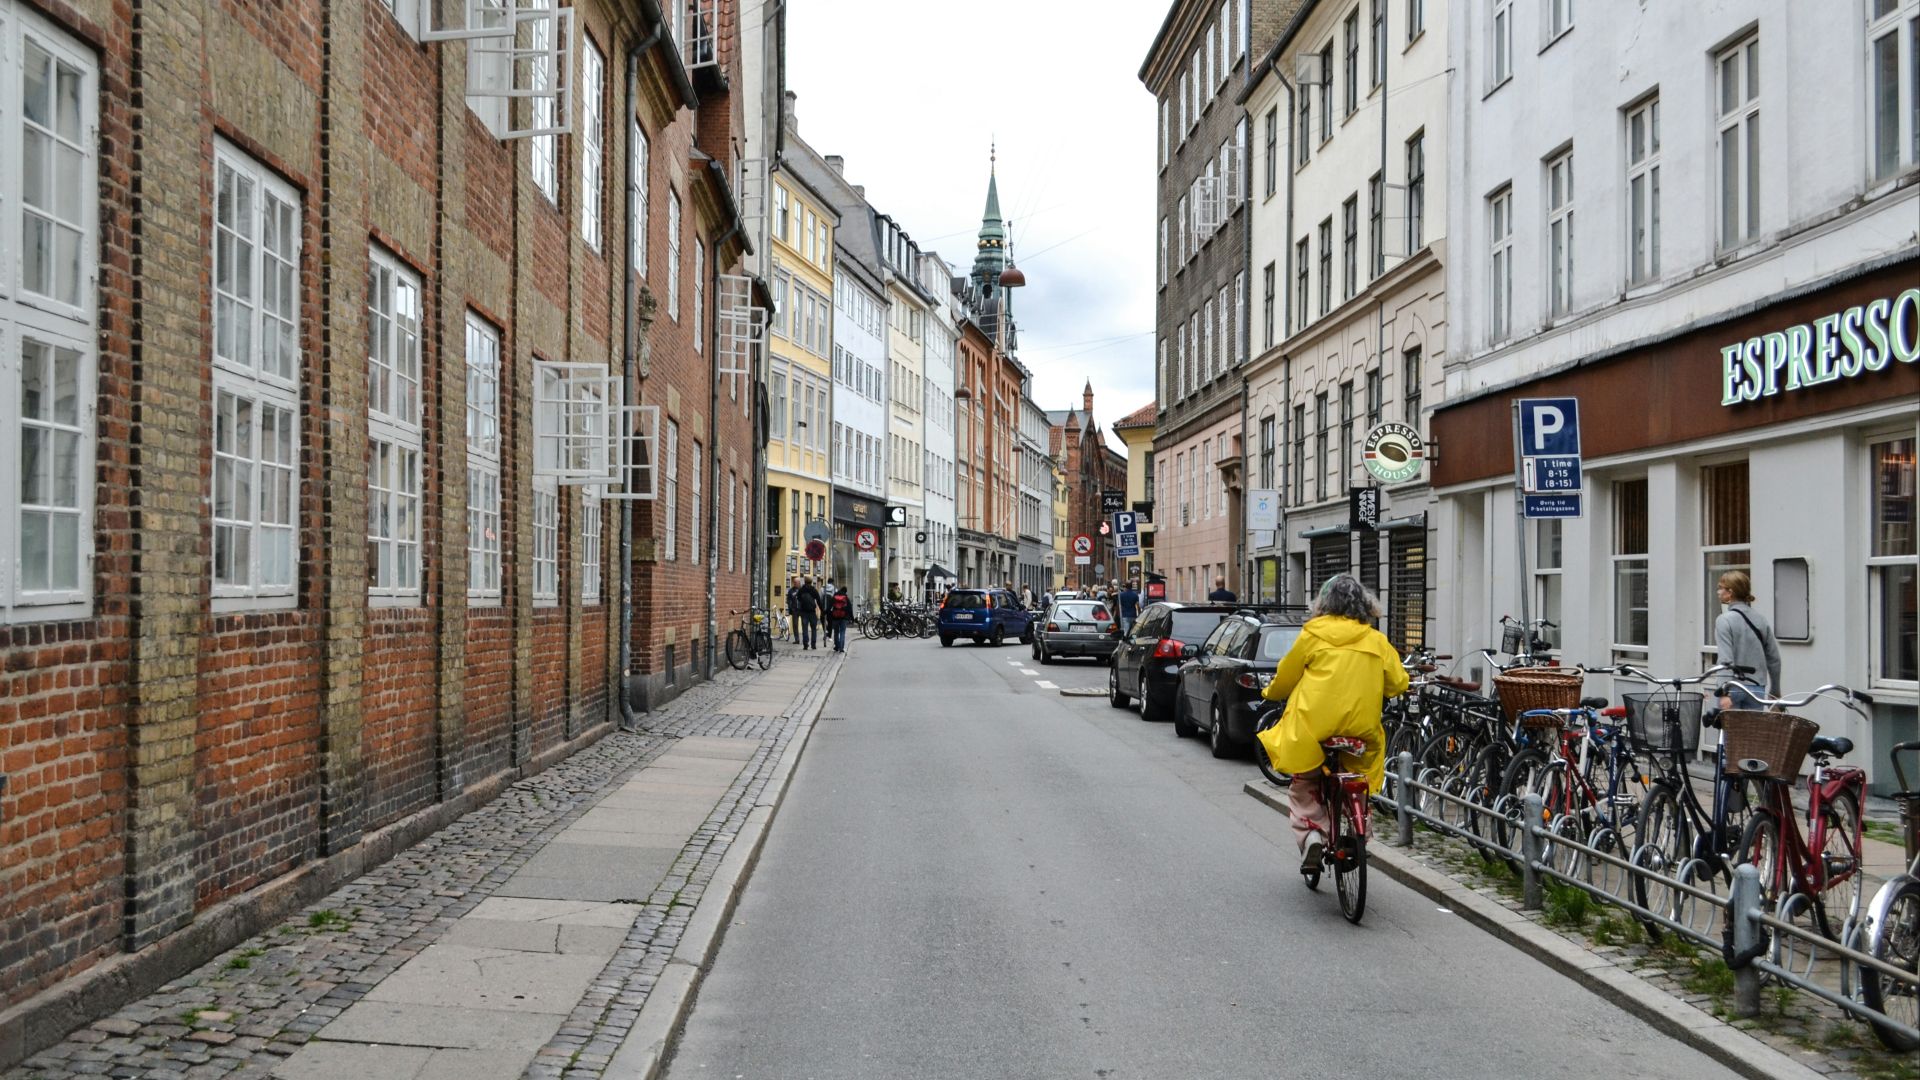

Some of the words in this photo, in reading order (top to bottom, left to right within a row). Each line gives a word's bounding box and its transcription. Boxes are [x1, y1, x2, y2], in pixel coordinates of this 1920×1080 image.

[1720, 288, 1920, 406] ESPRESSO
[1367, 424, 1420, 448] ESPRESSO
[1533, 405, 1565, 450] P
[1374, 464, 1416, 480] HOUSE
[1543, 460, 1547, 468] 1
[1551, 459, 1573, 468] time
[1548, 470, 1568, 478] 8-15
[1545, 479, 1573, 488] (8-15)
[1367, 490, 1376, 516] TIMES
[1119, 513, 1132, 532] P
[1367, 516, 1376, 527] UP
